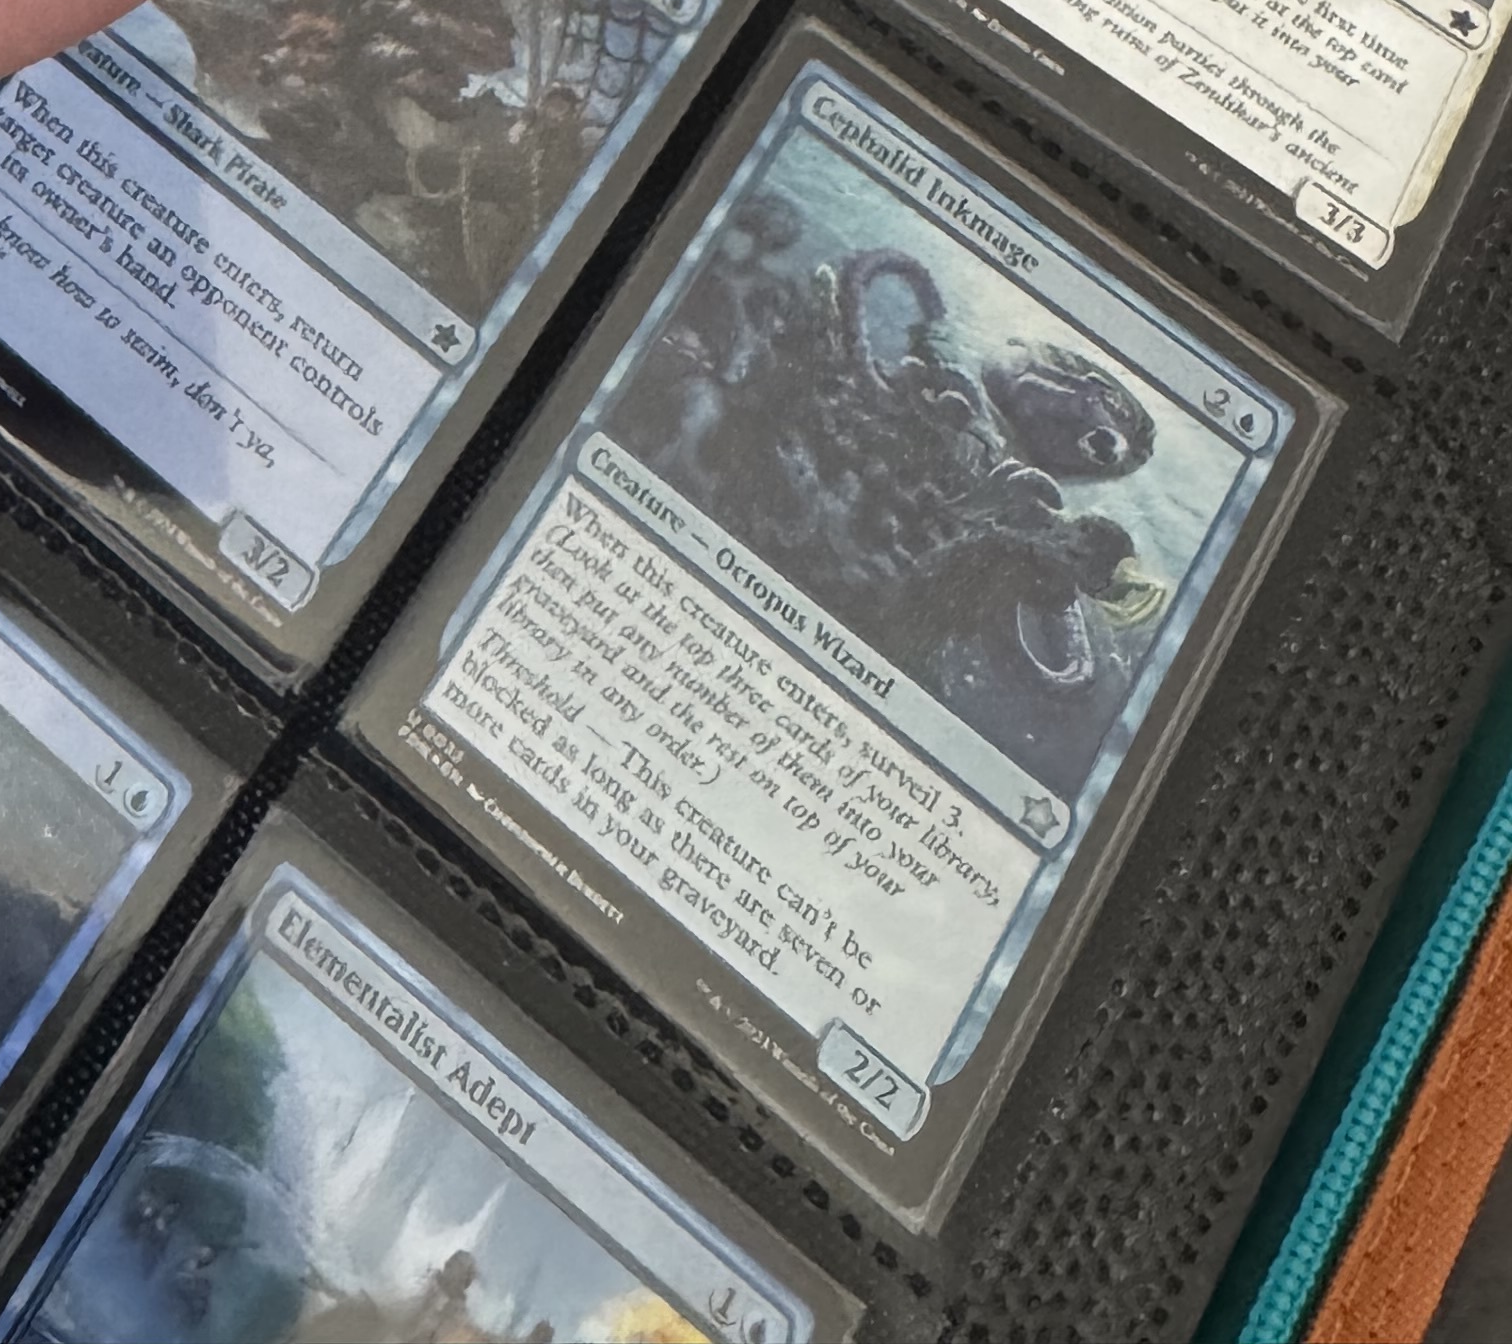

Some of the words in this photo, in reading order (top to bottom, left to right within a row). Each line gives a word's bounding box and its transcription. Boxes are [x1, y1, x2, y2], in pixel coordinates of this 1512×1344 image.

[807, 90, 929, 194] Cephalid
[922, 174, 1044, 280] Inkmage
[1315, 198, 1370, 247] 3/3
[239, 532, 294, 590] 3/2
[586, 442, 690, 537] Creature
[707, 542, 813, 642] Octopus
[807, 620, 897, 704] Wizard
[270, 906, 456, 1075] Elementalist
[441, 1052, 545, 1153] Adept
[842, 1047, 902, 1113] 2/2
